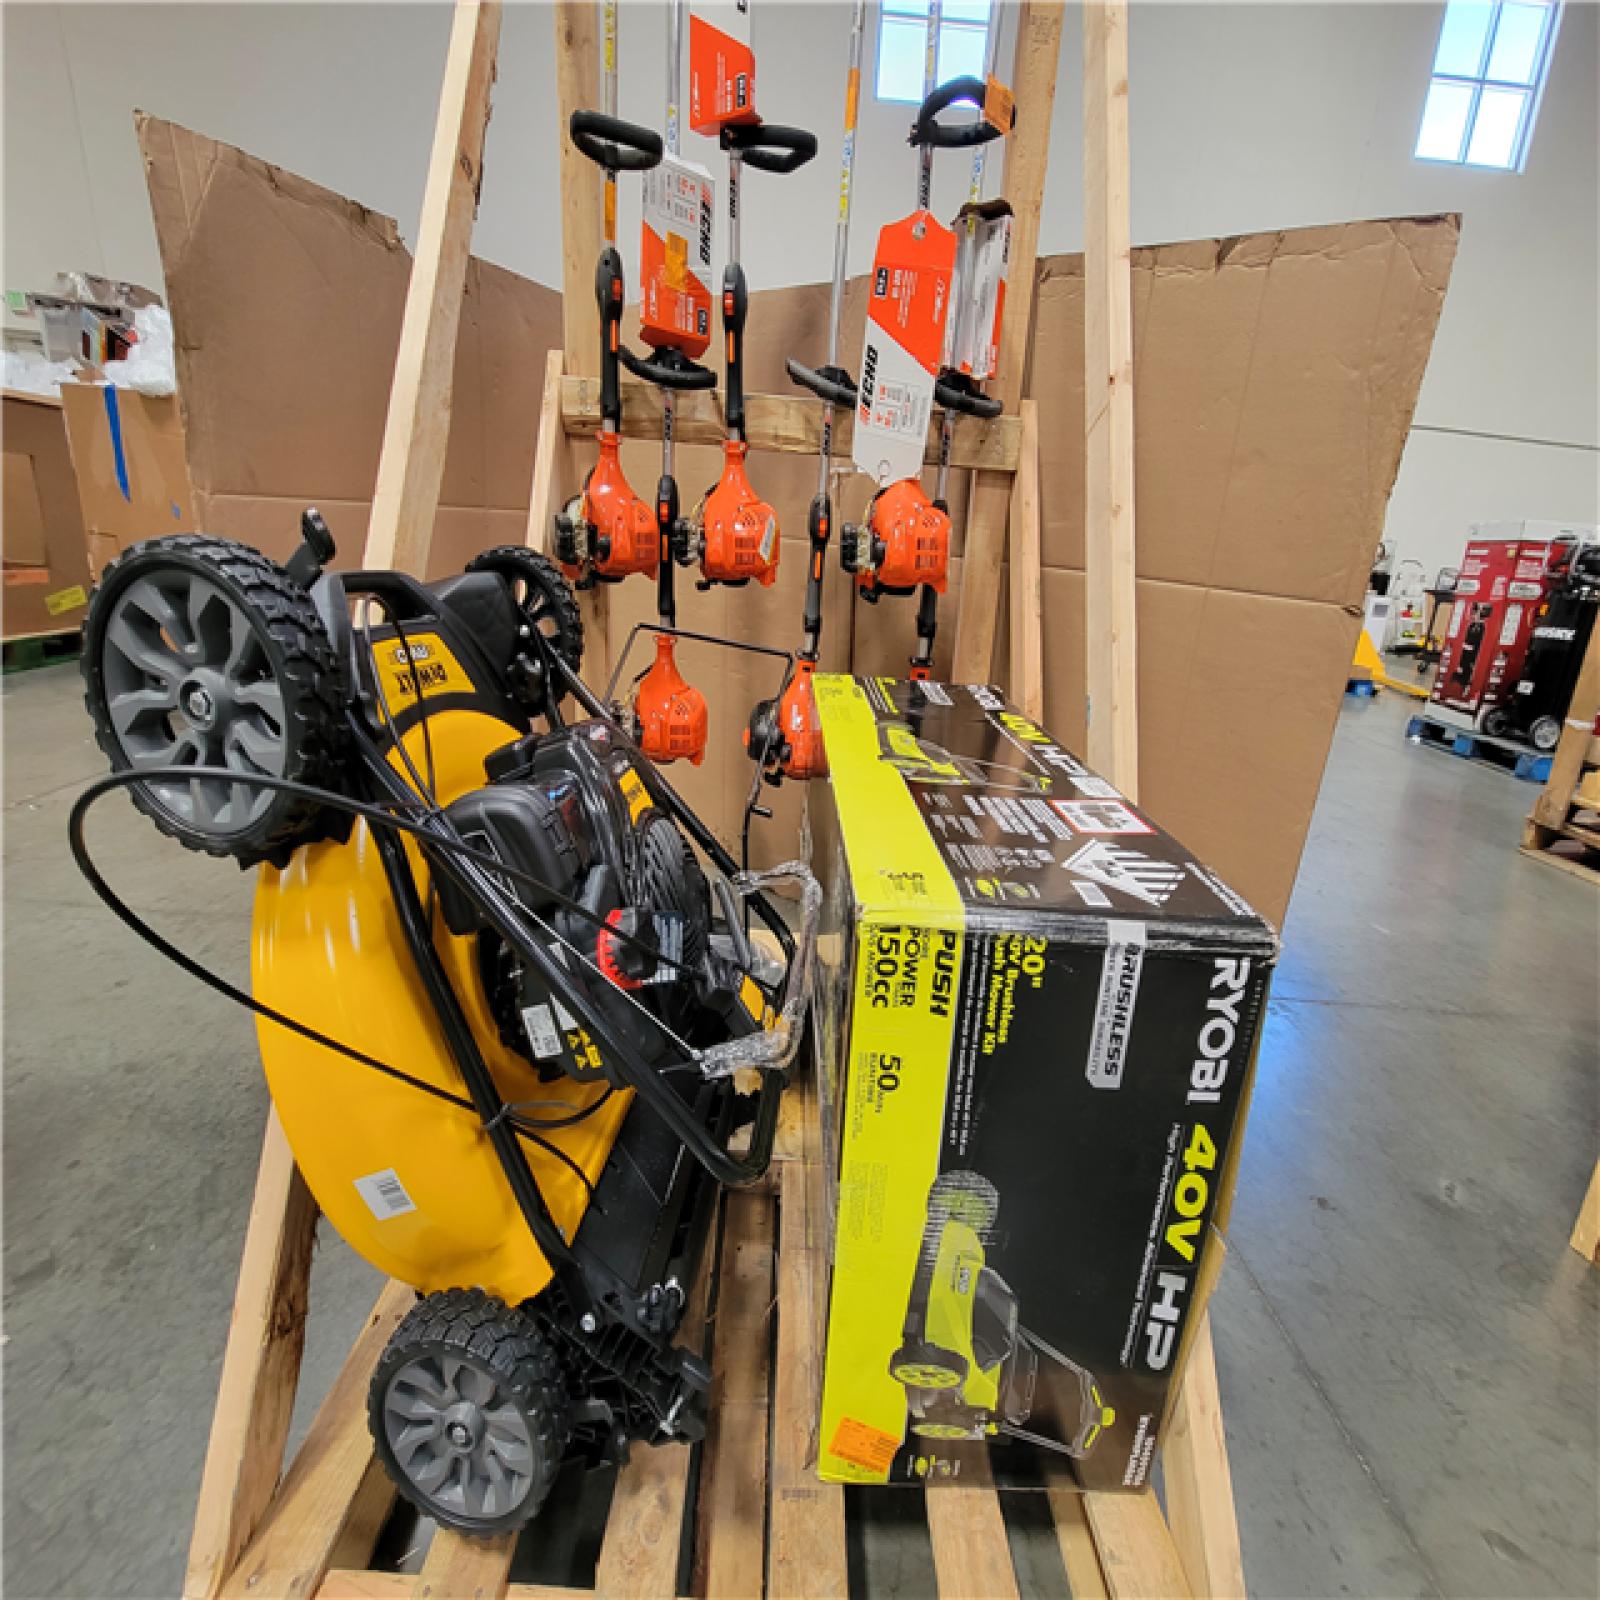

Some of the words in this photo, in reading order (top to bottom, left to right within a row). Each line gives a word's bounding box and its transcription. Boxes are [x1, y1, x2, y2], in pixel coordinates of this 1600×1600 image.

[700, 199, 711, 266] ECHO
[860, 344, 879, 409] ECHO
[871, 926, 901, 1009] 150cc
[899, 927, 920, 1006] POWER
[929, 928, 957, 1018] PUSH
[1021, 934, 1048, 989] 20"
[985, 973, 1005, 1030] Mower
[997, 968, 1019, 1044] Brushless
[1104, 942, 1141, 1076] BRUSHLESS
[1186, 956, 1251, 1103] RYOBI
[877, 1053, 901, 1092] 50
[982, 1030, 996, 1056] Kit
[1165, 1123, 1217, 1262] 40V
[1146, 1271, 1188, 1371] HP
